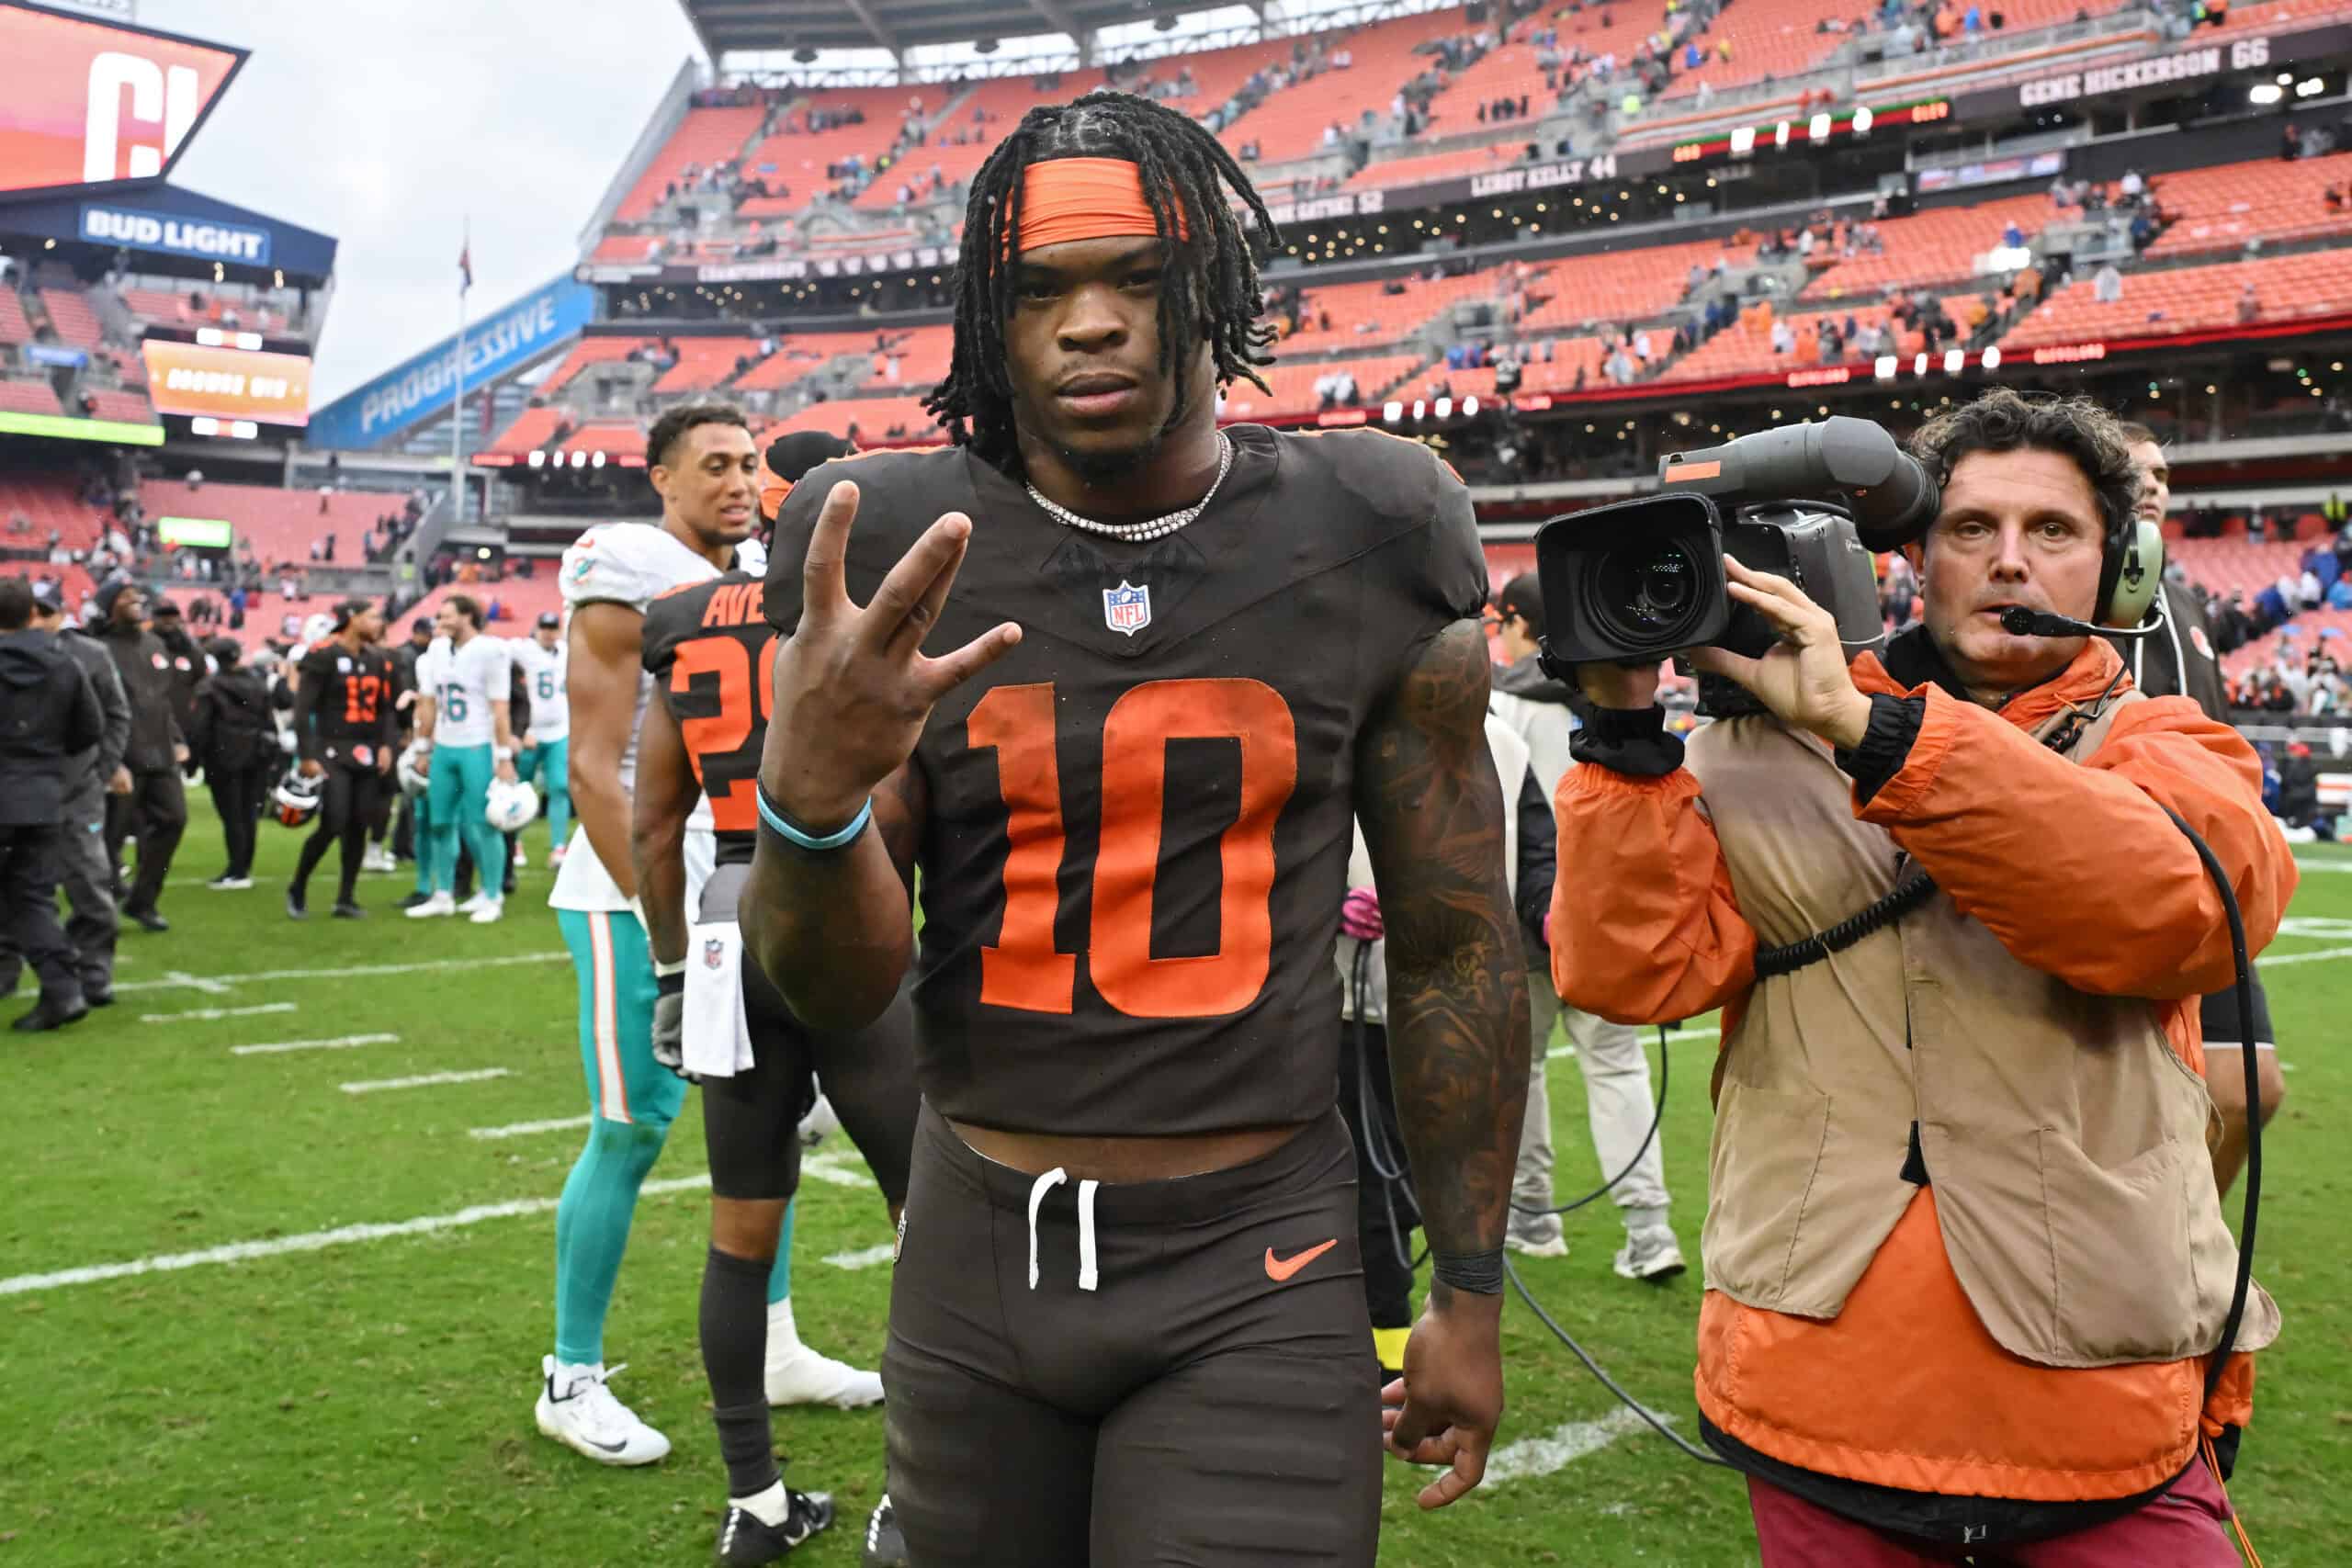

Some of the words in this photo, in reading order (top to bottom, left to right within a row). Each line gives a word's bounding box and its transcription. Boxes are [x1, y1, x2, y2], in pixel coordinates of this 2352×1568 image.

[2085, 49, 2221, 95] HICKERSON
[2232, 38, 2269, 70] 66
[1528, 161, 1584, 189] KELLY
[1589, 155, 1617, 181] 44
[87, 209, 162, 244] BUD
[164, 221, 264, 258] LIGHT
[361, 295, 556, 434] PROGRESSIVE
[1113, 604, 1144, 626] NFL
[345, 675, 379, 723] 13
[670, 635, 778, 831] 2
[967, 677, 1297, 1018] 10
